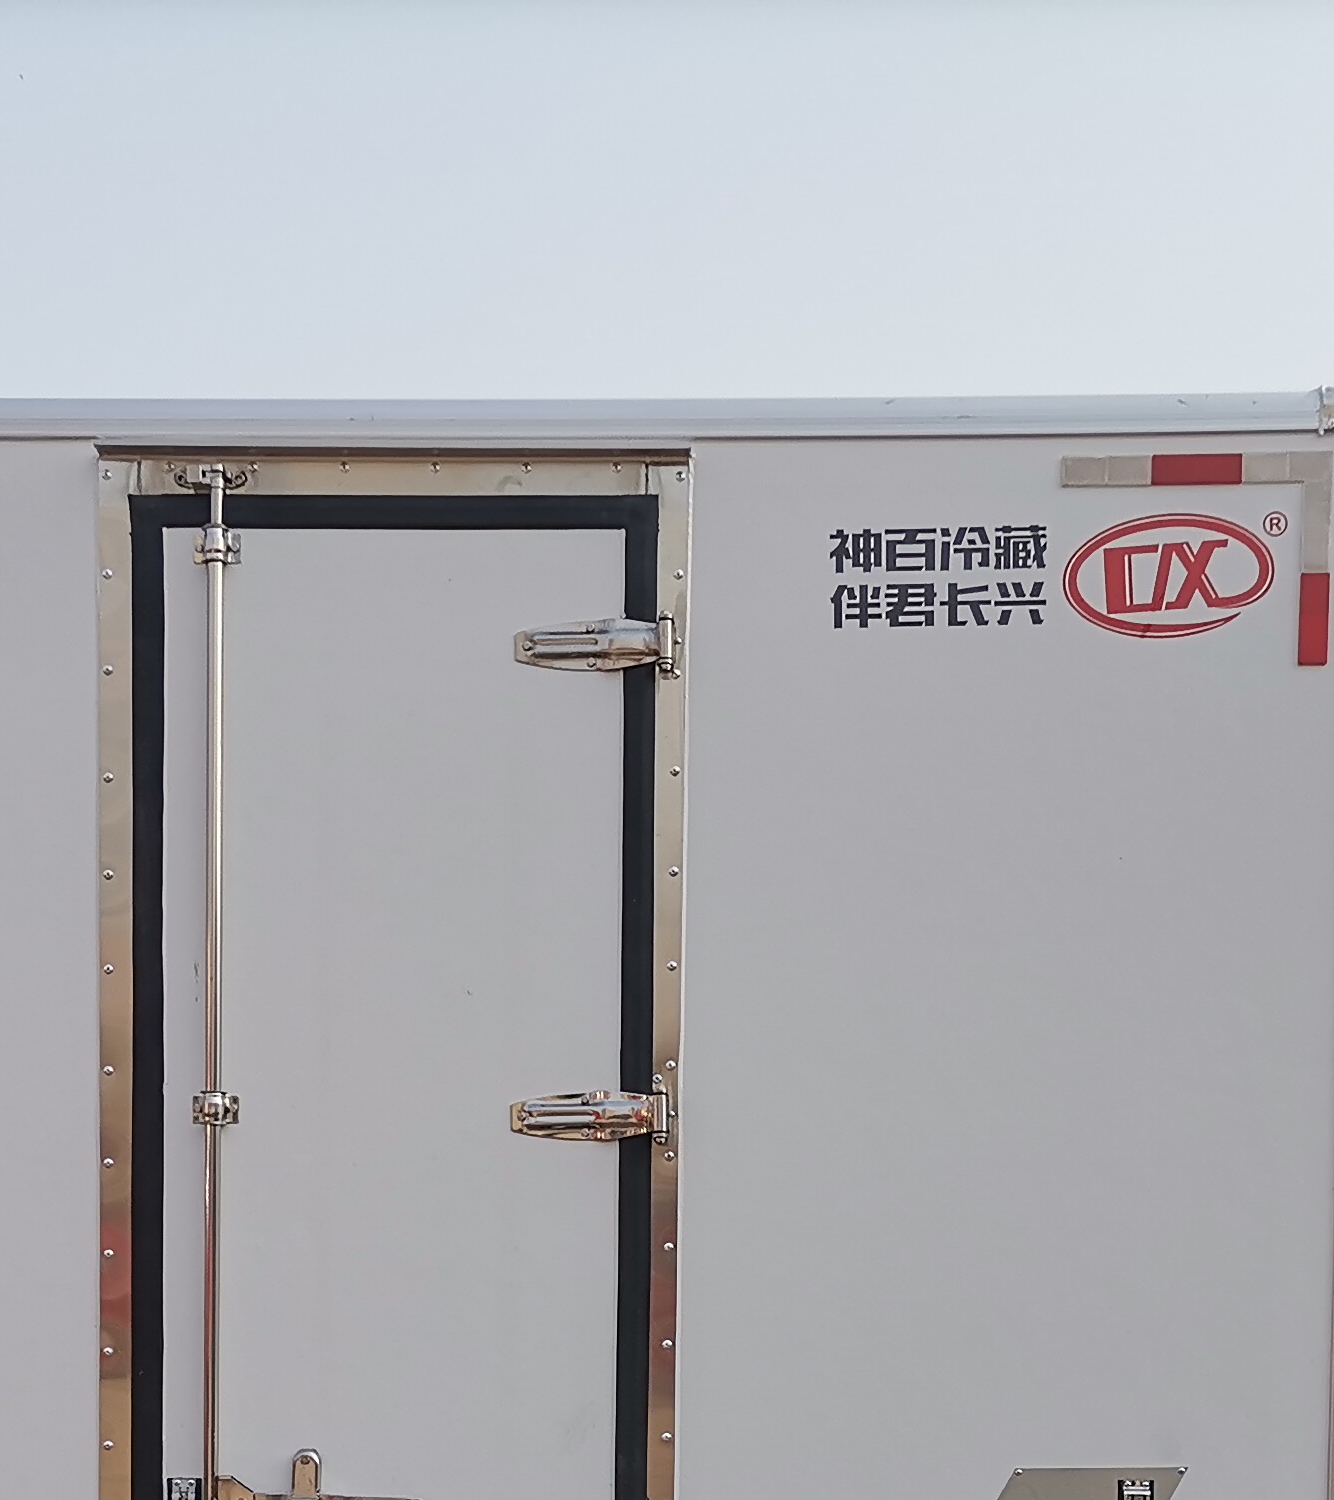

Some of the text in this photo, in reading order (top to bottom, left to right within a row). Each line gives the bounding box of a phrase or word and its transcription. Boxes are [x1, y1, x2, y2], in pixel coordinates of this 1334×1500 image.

[828, 524, 1047, 574] 神百冷藏
[829, 581, 1047, 629] 伴君长兴
